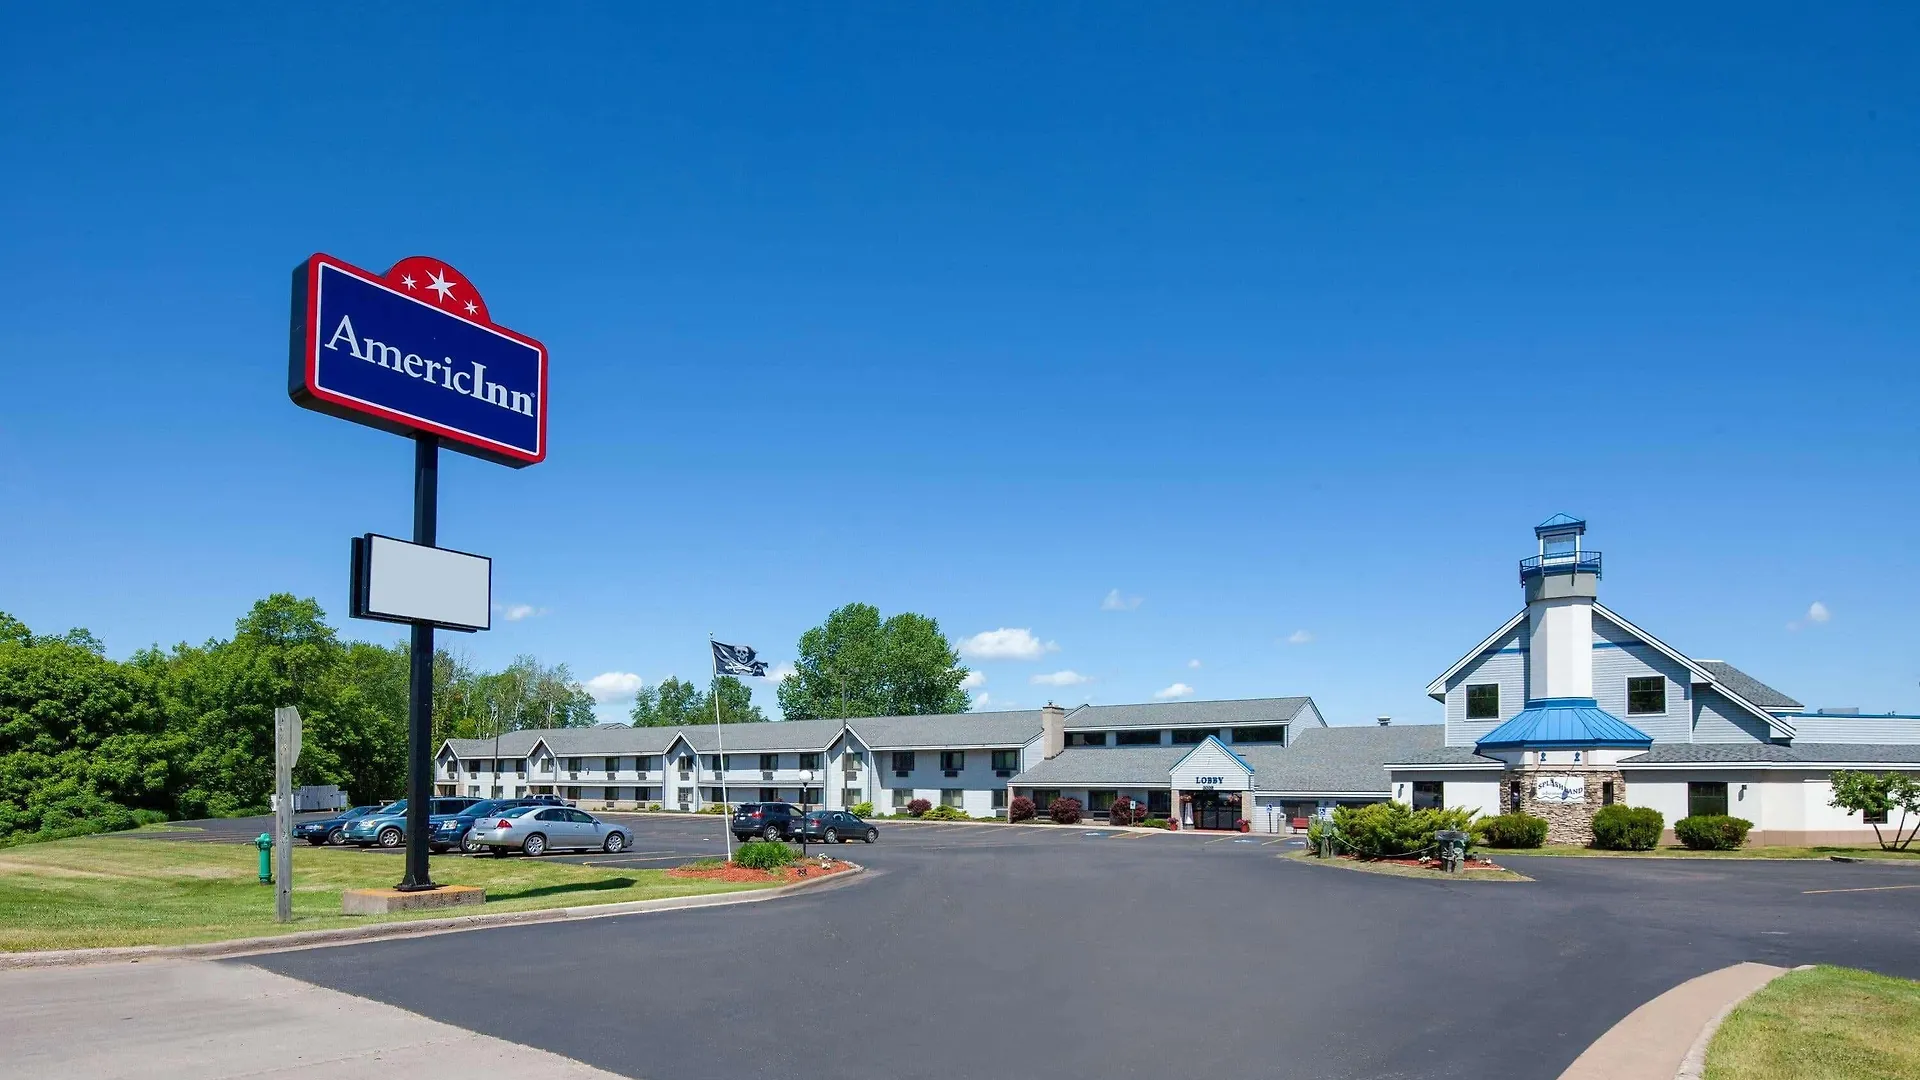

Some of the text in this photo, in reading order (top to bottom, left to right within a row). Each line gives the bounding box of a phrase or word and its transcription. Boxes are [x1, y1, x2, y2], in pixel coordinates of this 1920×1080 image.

[324, 314, 534, 417] AmericInn
[1195, 776, 1224, 784] LOBBY
[1538, 778, 1583, 795] SPLASHAND
